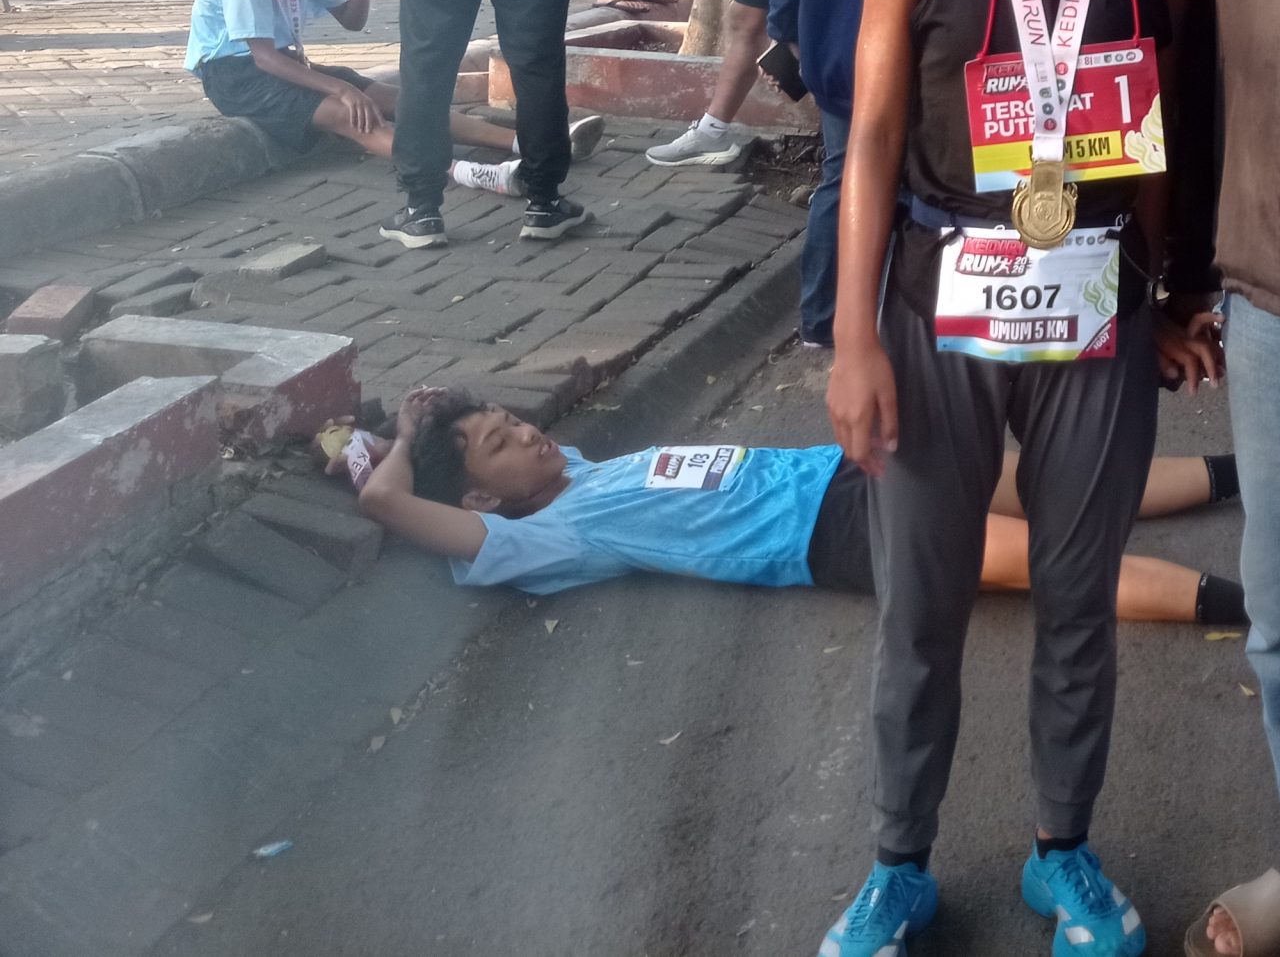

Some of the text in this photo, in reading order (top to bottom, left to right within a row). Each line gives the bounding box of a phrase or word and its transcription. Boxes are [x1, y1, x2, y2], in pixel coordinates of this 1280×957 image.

[986, 75, 1018, 93] RUN
[981, 92, 1094, 121] TERCAT
[1114, 74, 1132, 124] 1
[1076, 141, 1085, 158] 5
[1088, 137, 1111, 156] KM
[982, 284, 1061, 311] 1607
[989, 319, 1032, 340] UMUM
[1034, 320, 1044, 339] 5
[1049, 320, 1069, 339] KM
